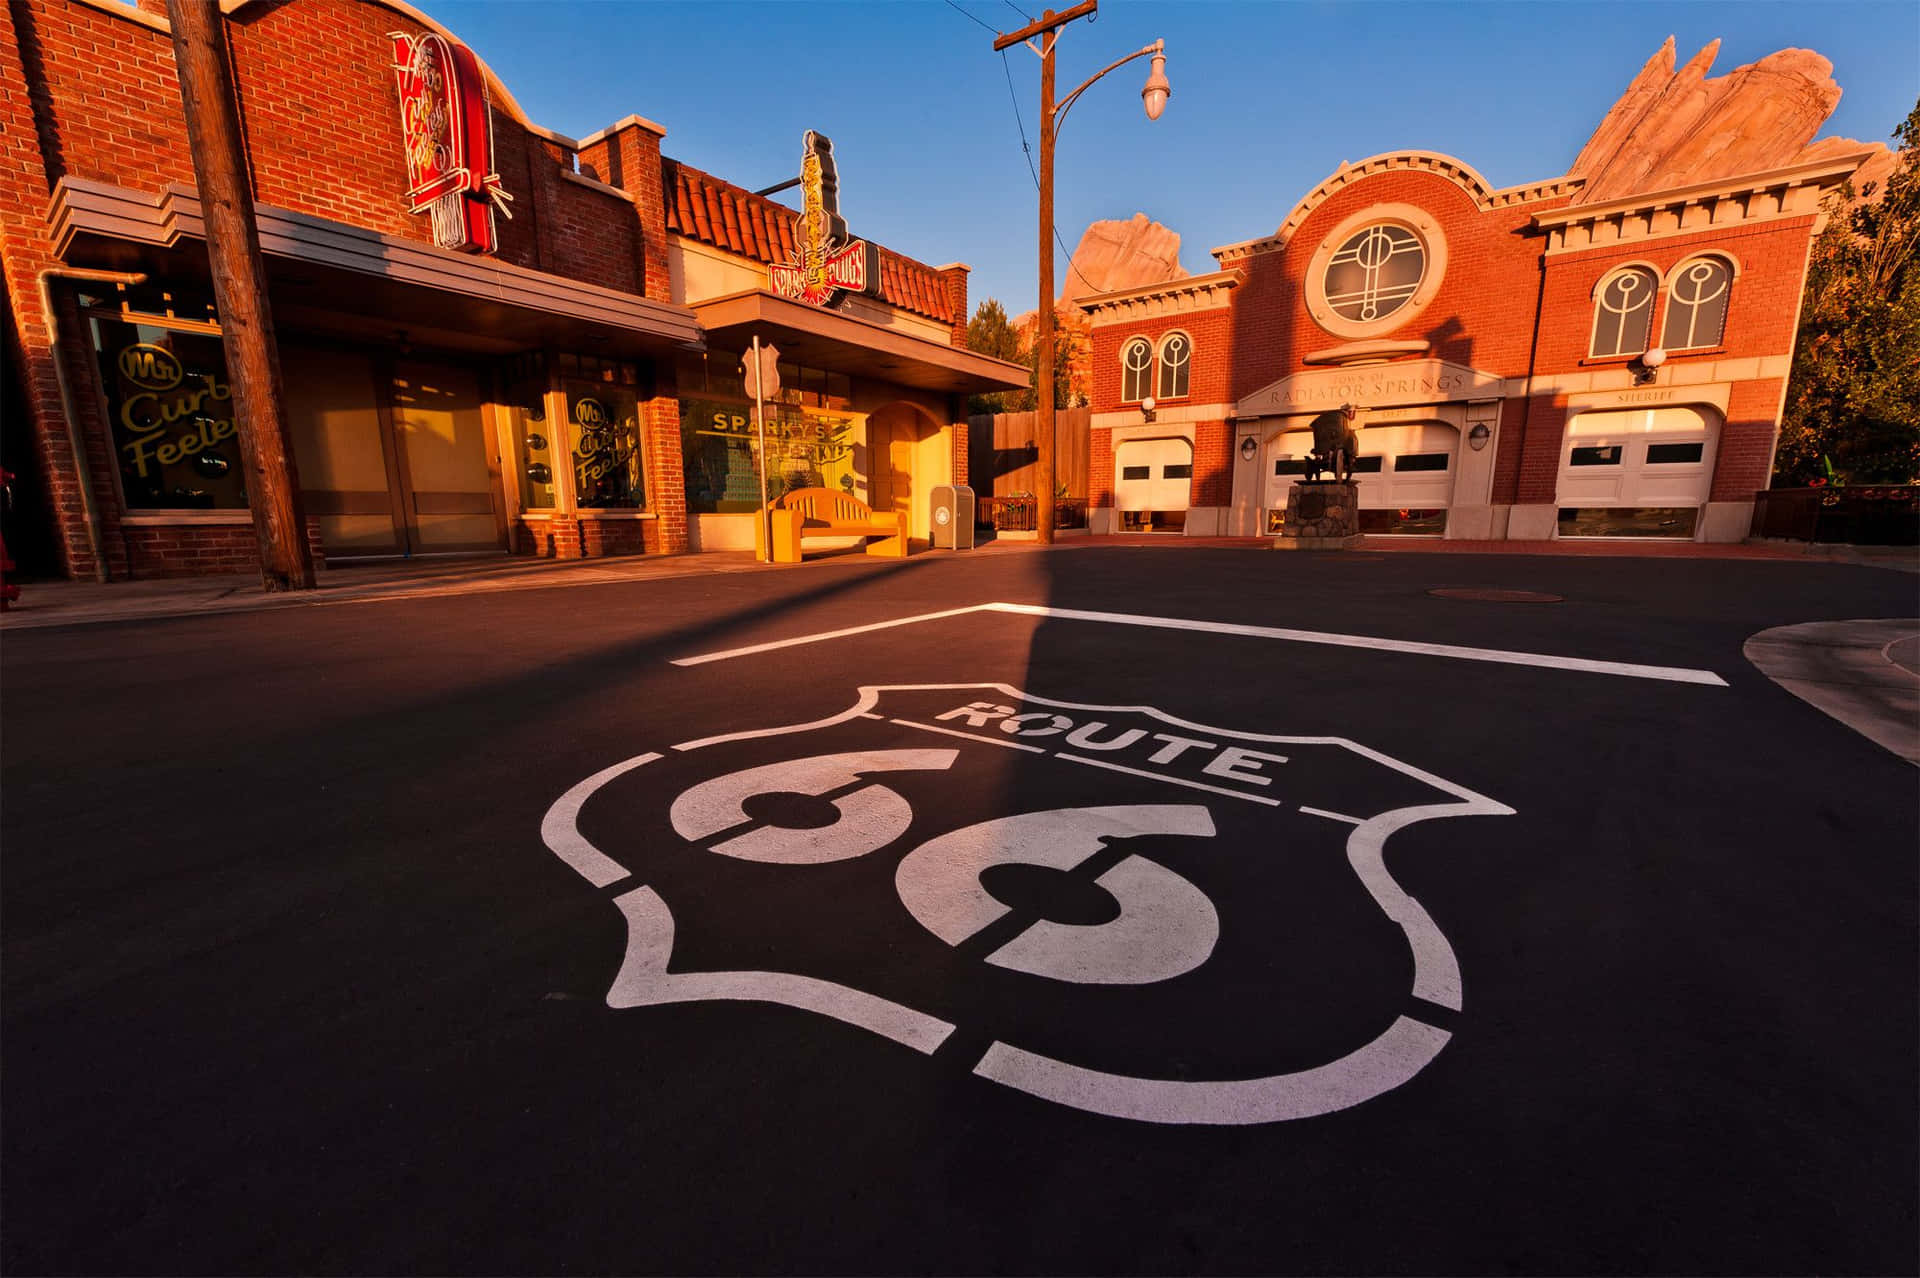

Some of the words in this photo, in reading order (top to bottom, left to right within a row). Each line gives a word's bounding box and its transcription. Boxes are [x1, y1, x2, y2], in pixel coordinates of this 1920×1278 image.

[774, 269, 806, 297] SPARK
[829, 246, 863, 285] PLUGS
[126, 351, 177, 380] Mr
[1271, 383, 1364, 403] RADIATOR
[1374, 374, 1465, 395] SPRINGS
[121, 374, 231, 432] Curb
[1618, 391, 1672, 402] SHERIFF
[935, 702, 1289, 786] ROUTE
[670, 748, 1220, 984] 66
